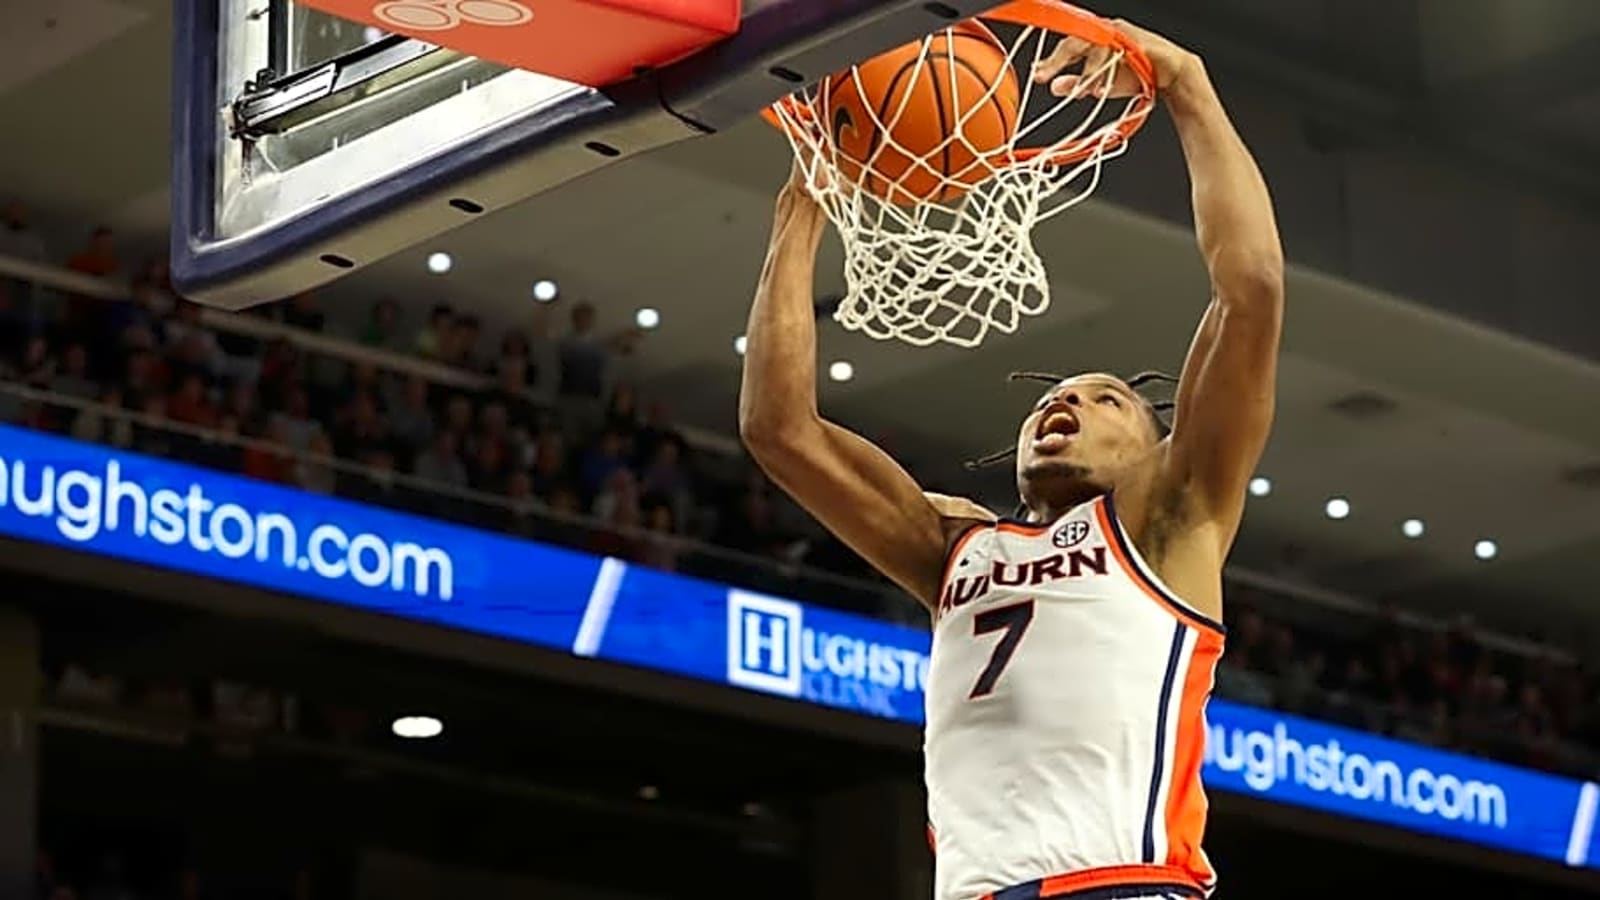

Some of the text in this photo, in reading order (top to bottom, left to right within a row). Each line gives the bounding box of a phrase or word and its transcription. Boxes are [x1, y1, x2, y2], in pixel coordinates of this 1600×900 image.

[1054, 523, 1088, 545] SEC
[969, 600, 1035, 699] 7
[1204, 722, 1507, 828] ughston.com
